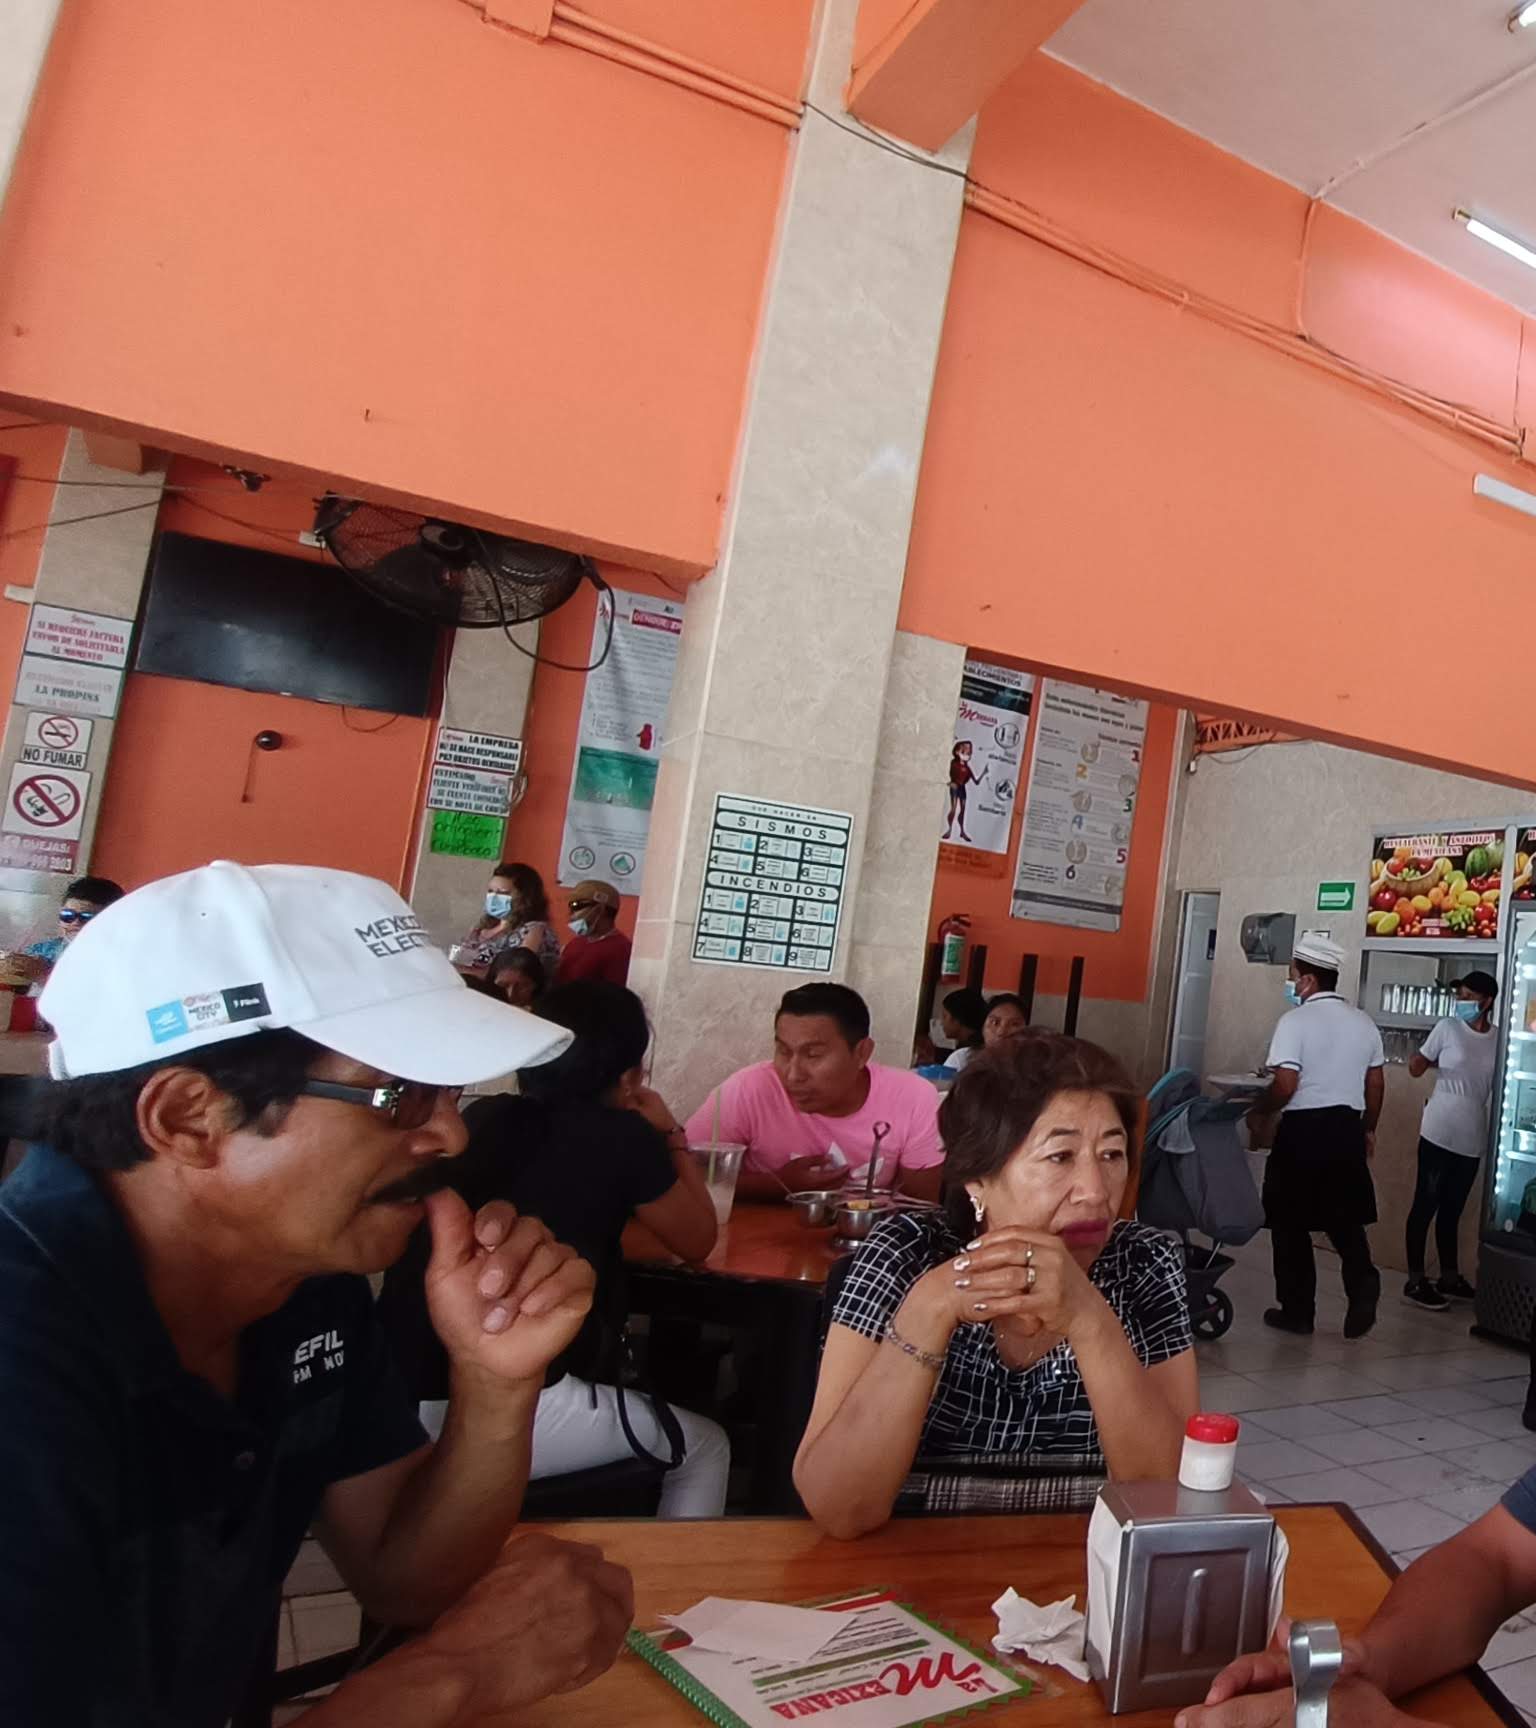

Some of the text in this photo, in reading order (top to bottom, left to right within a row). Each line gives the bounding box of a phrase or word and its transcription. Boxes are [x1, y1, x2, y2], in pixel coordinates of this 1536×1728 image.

[480, 737, 519, 749] EMPRESA
[458, 745, 475, 755] HACE
[23, 749, 82, 767] NO FUMAR
[737, 816, 828, 841] SISMOS
[759, 839, 769, 851] 2
[804, 847, 813, 858] 3
[1116, 848, 1128, 864] 5
[710, 854, 719, 865] 4
[756, 861, 766, 872] 5
[1065, 864, 1076, 880] 6
[801, 867, 810, 878] 6
[720, 875, 827, 898] INCENDIOS
[750, 899, 760, 910] 2
[795, 904, 804, 915] 3
[700, 916, 709, 927] 4
[747, 922, 756, 934] 5
[792, 928, 801, 939] 6
[697, 942, 706, 953] 7
[743, 946, 753, 957] 8
[789, 951, 798, 962] 9
[959, 1676, 1000, 1694] La
